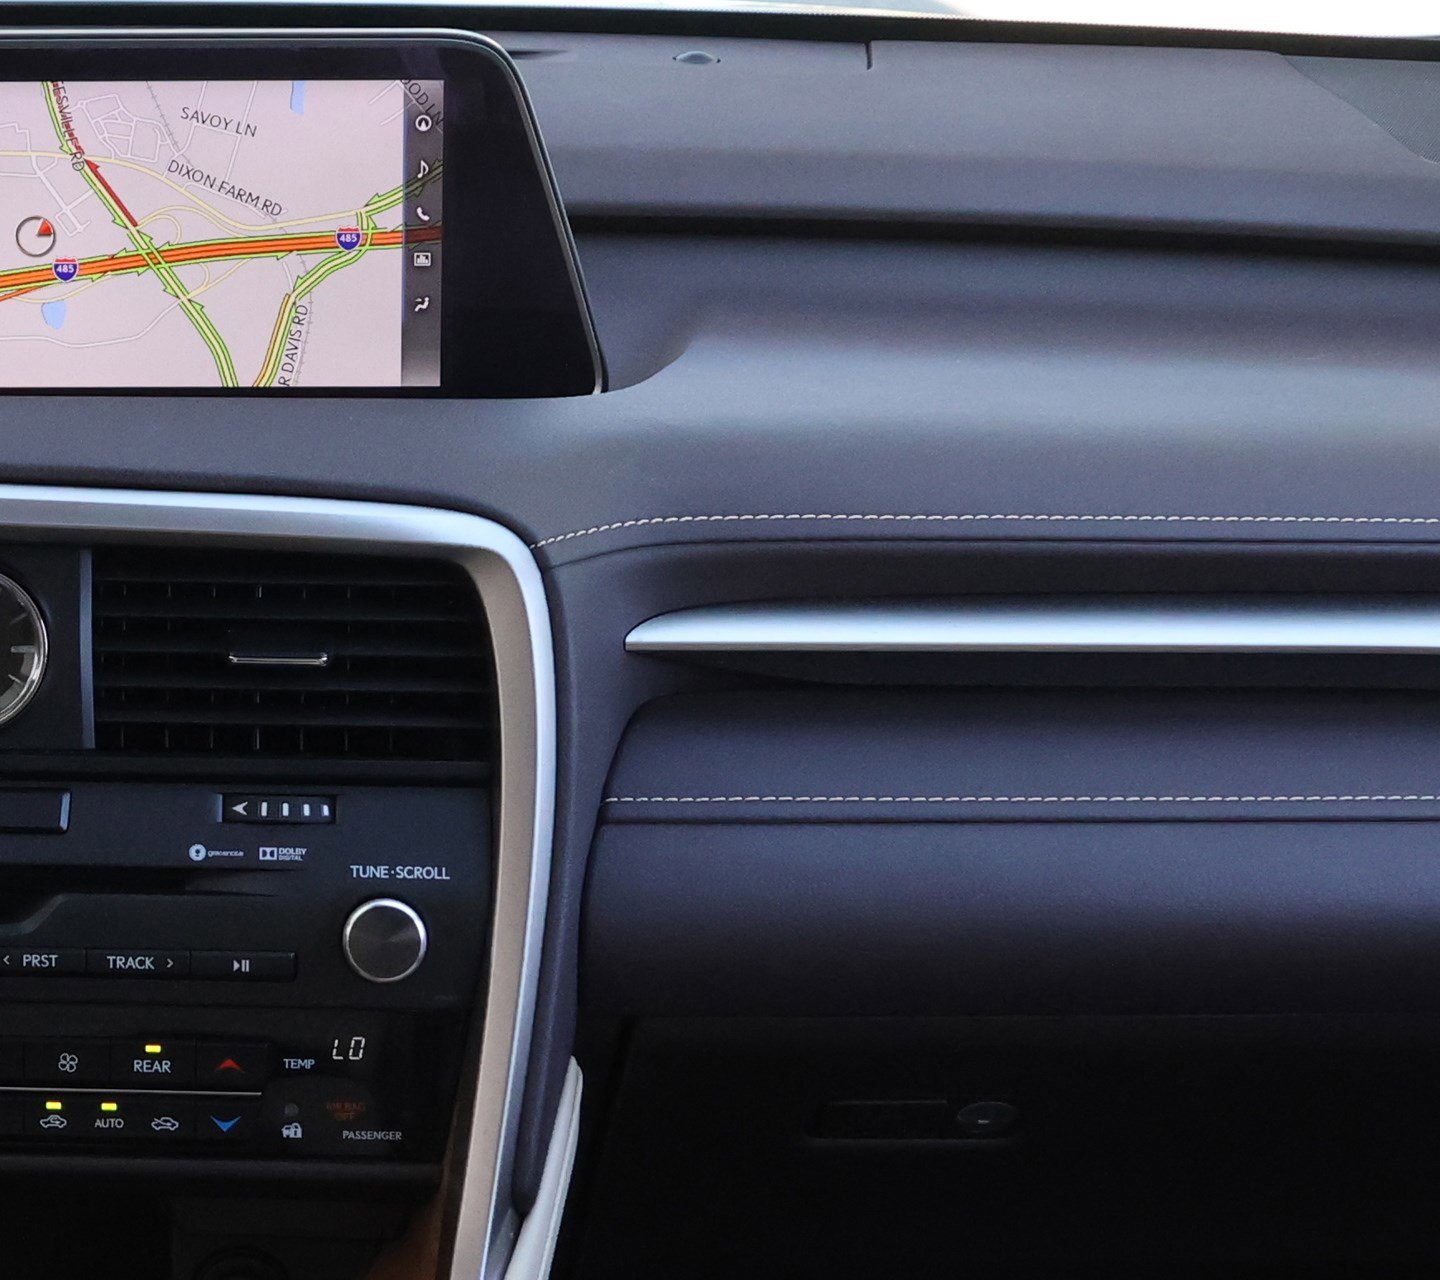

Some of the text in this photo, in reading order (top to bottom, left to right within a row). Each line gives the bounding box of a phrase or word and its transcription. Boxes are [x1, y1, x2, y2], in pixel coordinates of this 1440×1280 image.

[52, 80, 85, 171] ESVILLE RD
[180, 106, 258, 138] SAVOY LN
[167, 159, 283, 217] DIXON FARM RD
[339, 233, 357, 243] 485
[56, 264, 75, 274] 485
[281, 328, 303, 374] DAVIS
[293, 304, 309, 325] RD
[278, 847, 307, 856] DOLBY
[22, 954, 58, 968] PRST
[106, 956, 155, 970] TRACK
[133, 1058, 171, 1073] REAR
[283, 1058, 315, 1070] TEMP
[94, 1118, 124, 1129] AUTO
[342, 1130, 402, 1141] PASSENGER
